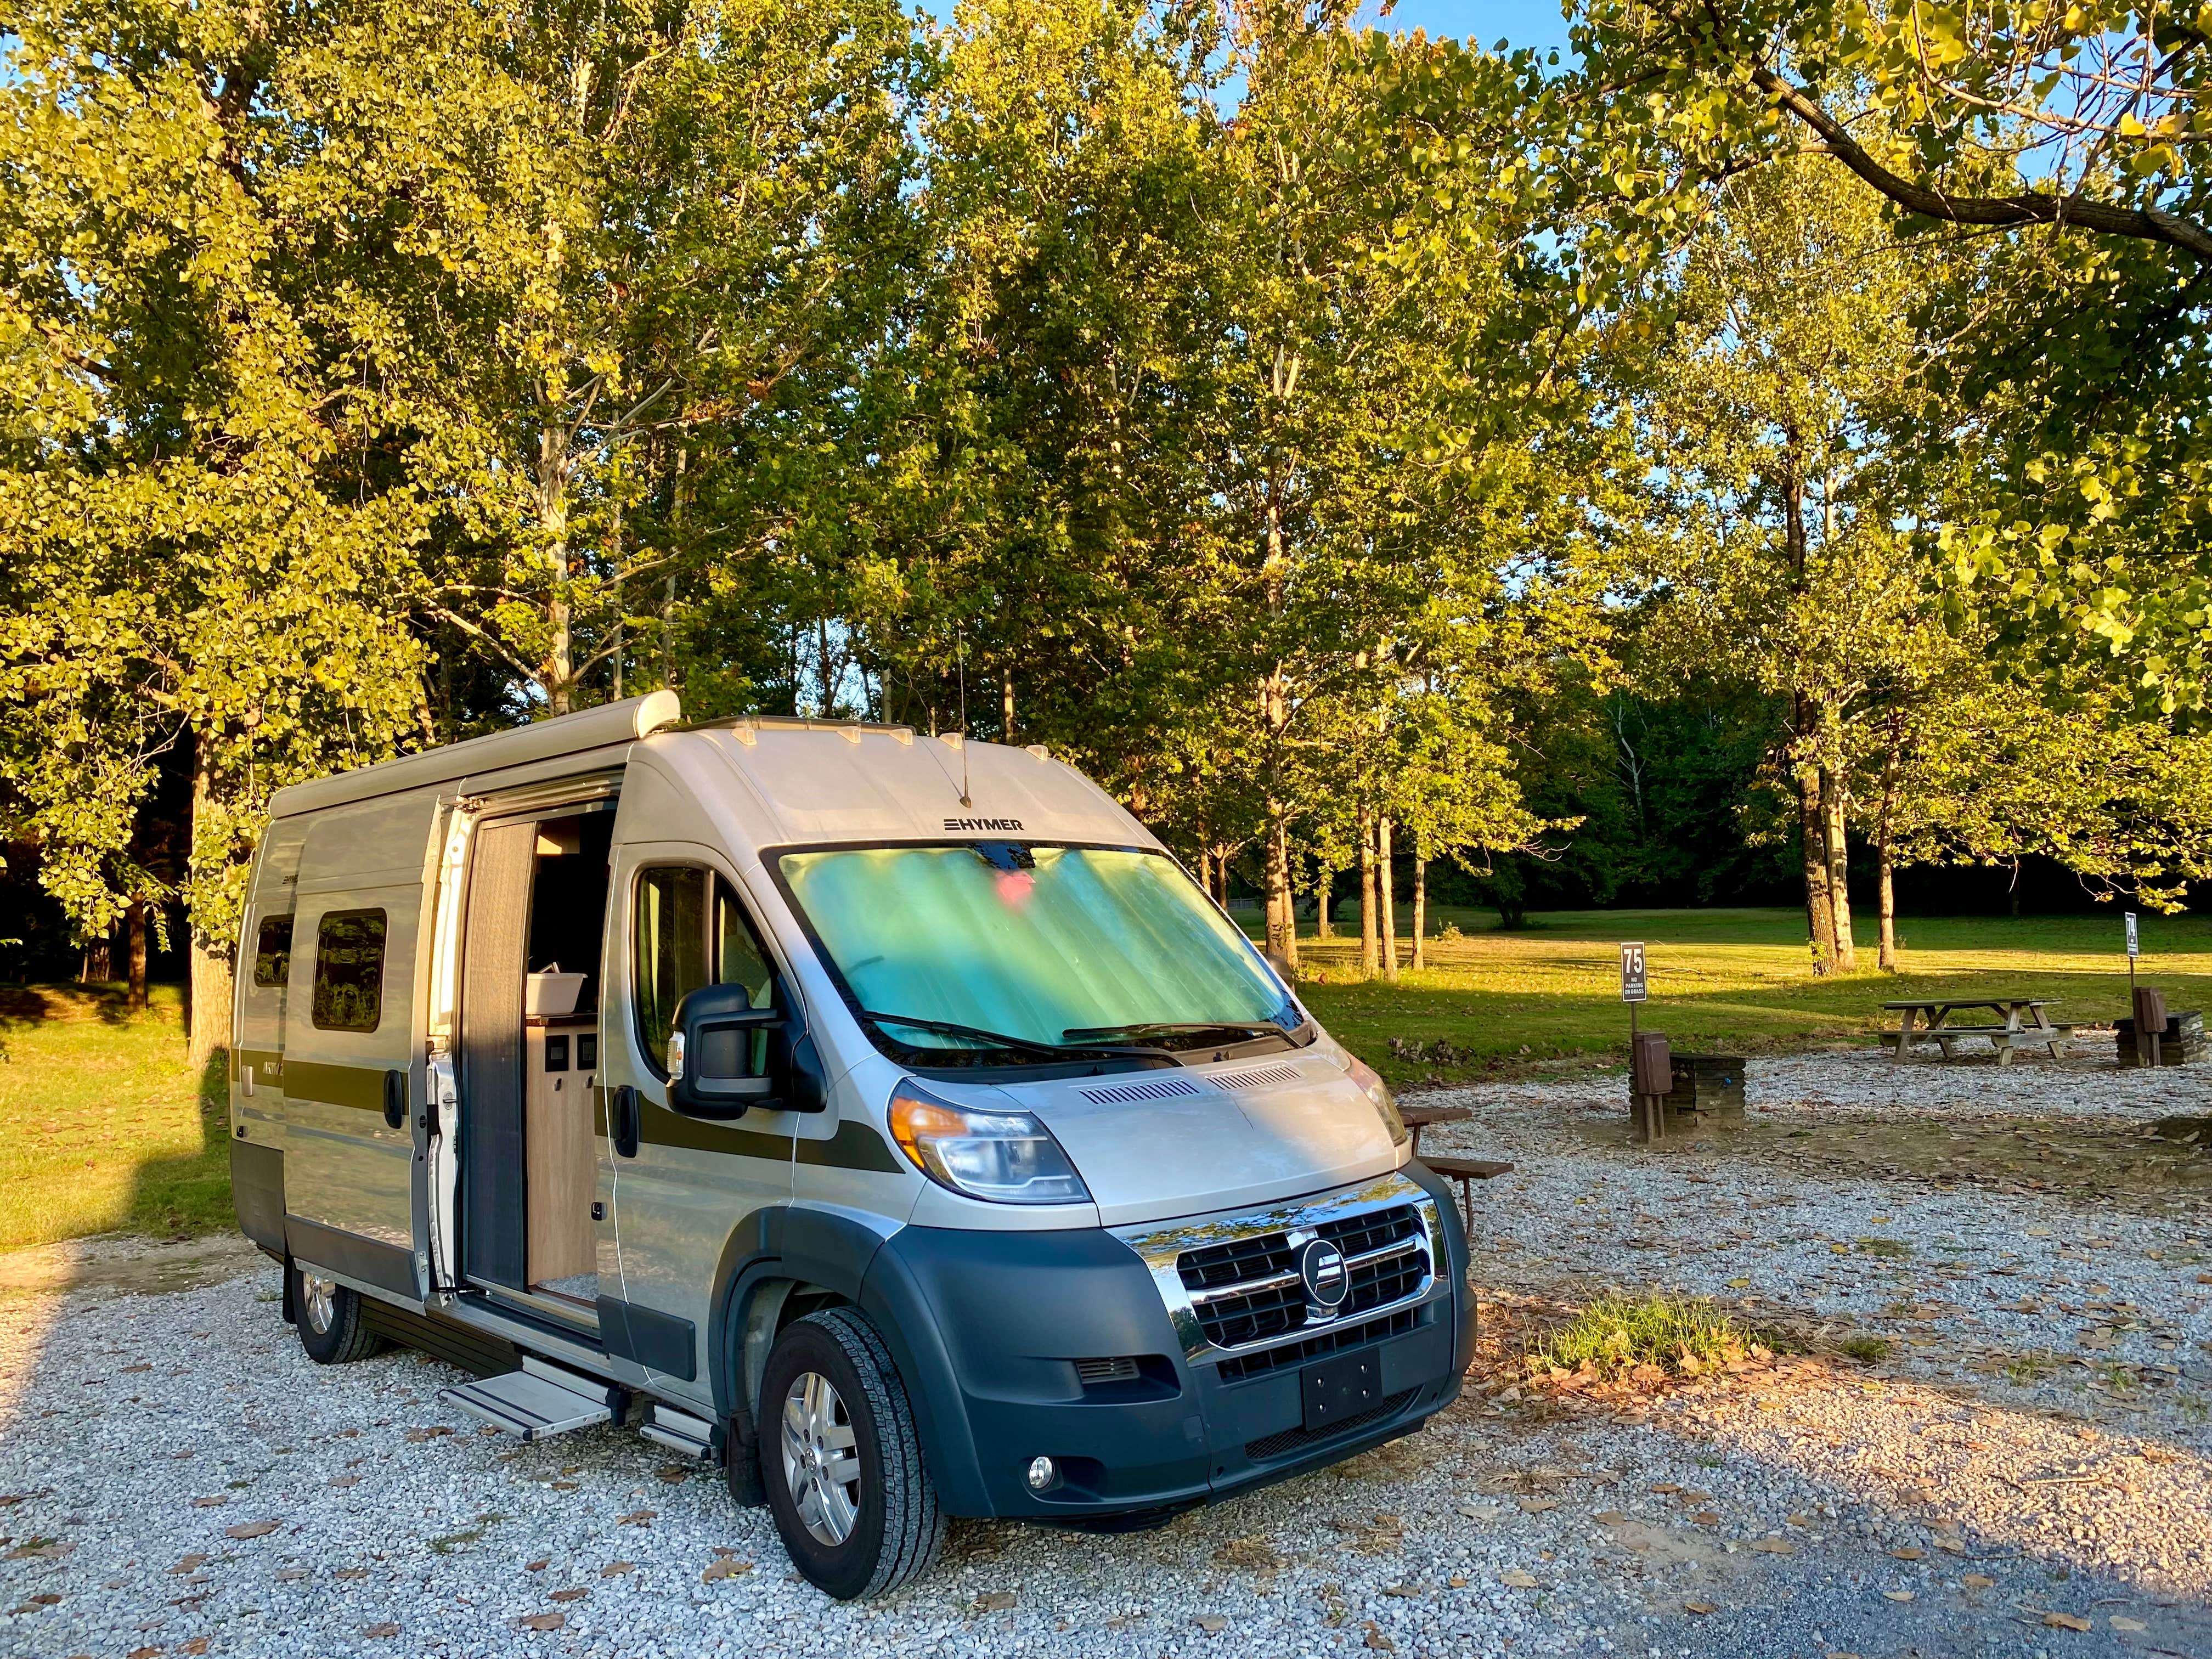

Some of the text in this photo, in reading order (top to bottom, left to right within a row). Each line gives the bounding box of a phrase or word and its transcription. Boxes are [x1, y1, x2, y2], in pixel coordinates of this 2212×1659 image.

[957, 819, 1025, 831] HYMER
[2127, 917, 2135, 936] 74
[1624, 948, 1643, 973] 75
